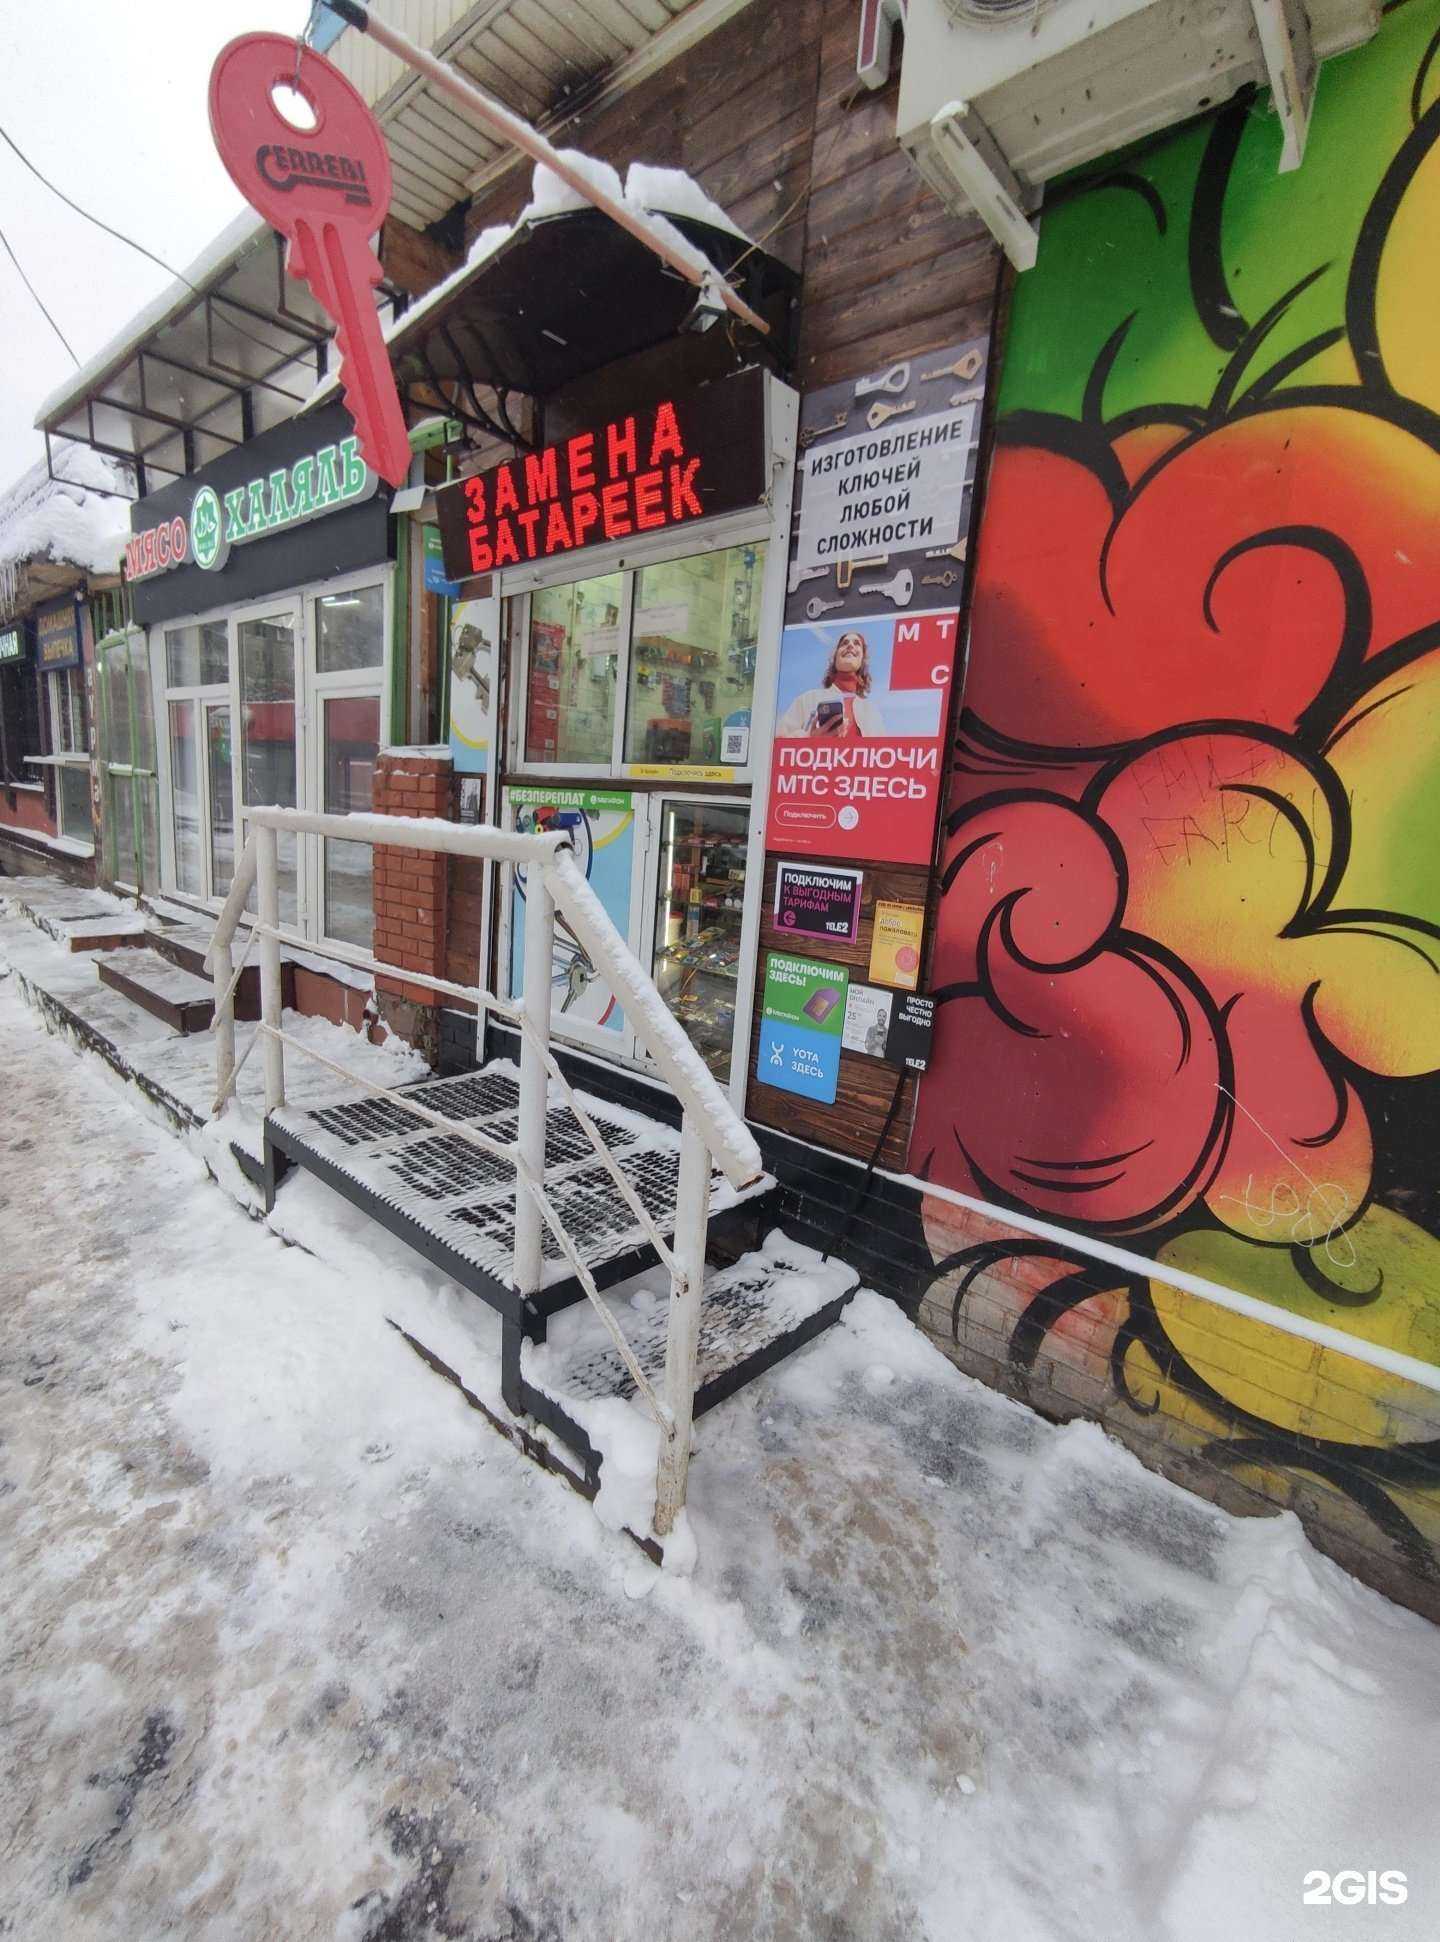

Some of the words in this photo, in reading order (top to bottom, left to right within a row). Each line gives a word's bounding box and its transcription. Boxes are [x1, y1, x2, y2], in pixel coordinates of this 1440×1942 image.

[811, 419, 963, 477] ИЗГОТОВЛЕНИЕ
[464, 401, 684, 524] ЗАМЕНА
[838, 457, 921, 497] КЛЮЧЕЙ
[124, 516, 187, 581] МЯСО
[224, 436, 367, 543] ХАЛЯЛЬ
[468, 458, 702, 572] БАТАРЕЕК
[839, 488, 911, 524] ЛЮБОЙ
[816, 517, 934, 555] СЛОЖНОСТИ
[779, 747, 938, 771] ПОДКЛЮЧИ
[777, 774, 829, 794] МТС
[833, 775, 927, 800] ЗДЕСЬ
[784, 872, 852, 891] ПОДКЛЮЧИМ
[783, 885, 791, 895] К
[792, 886, 852, 903] ВЫГОДНЫМ
[783, 896, 829, 912] ТАРИФАМ
[825, 922, 849, 933] TELE2
[769, 970, 807, 987] ЗДЕСЬ!
[770, 958, 845, 983] ПОДКЛЮЧИМ
[906, 996, 934, 1009] ПРОСТО
[906, 1005, 933, 1018] ЧЕСТНО
[898, 1012, 931, 1028] ВЫГОДНО
[792, 1048, 820, 1064] YOTA
[905, 1057, 926, 1071] TELE2
[791, 1061, 824, 1078] ЗДЕСЬ
